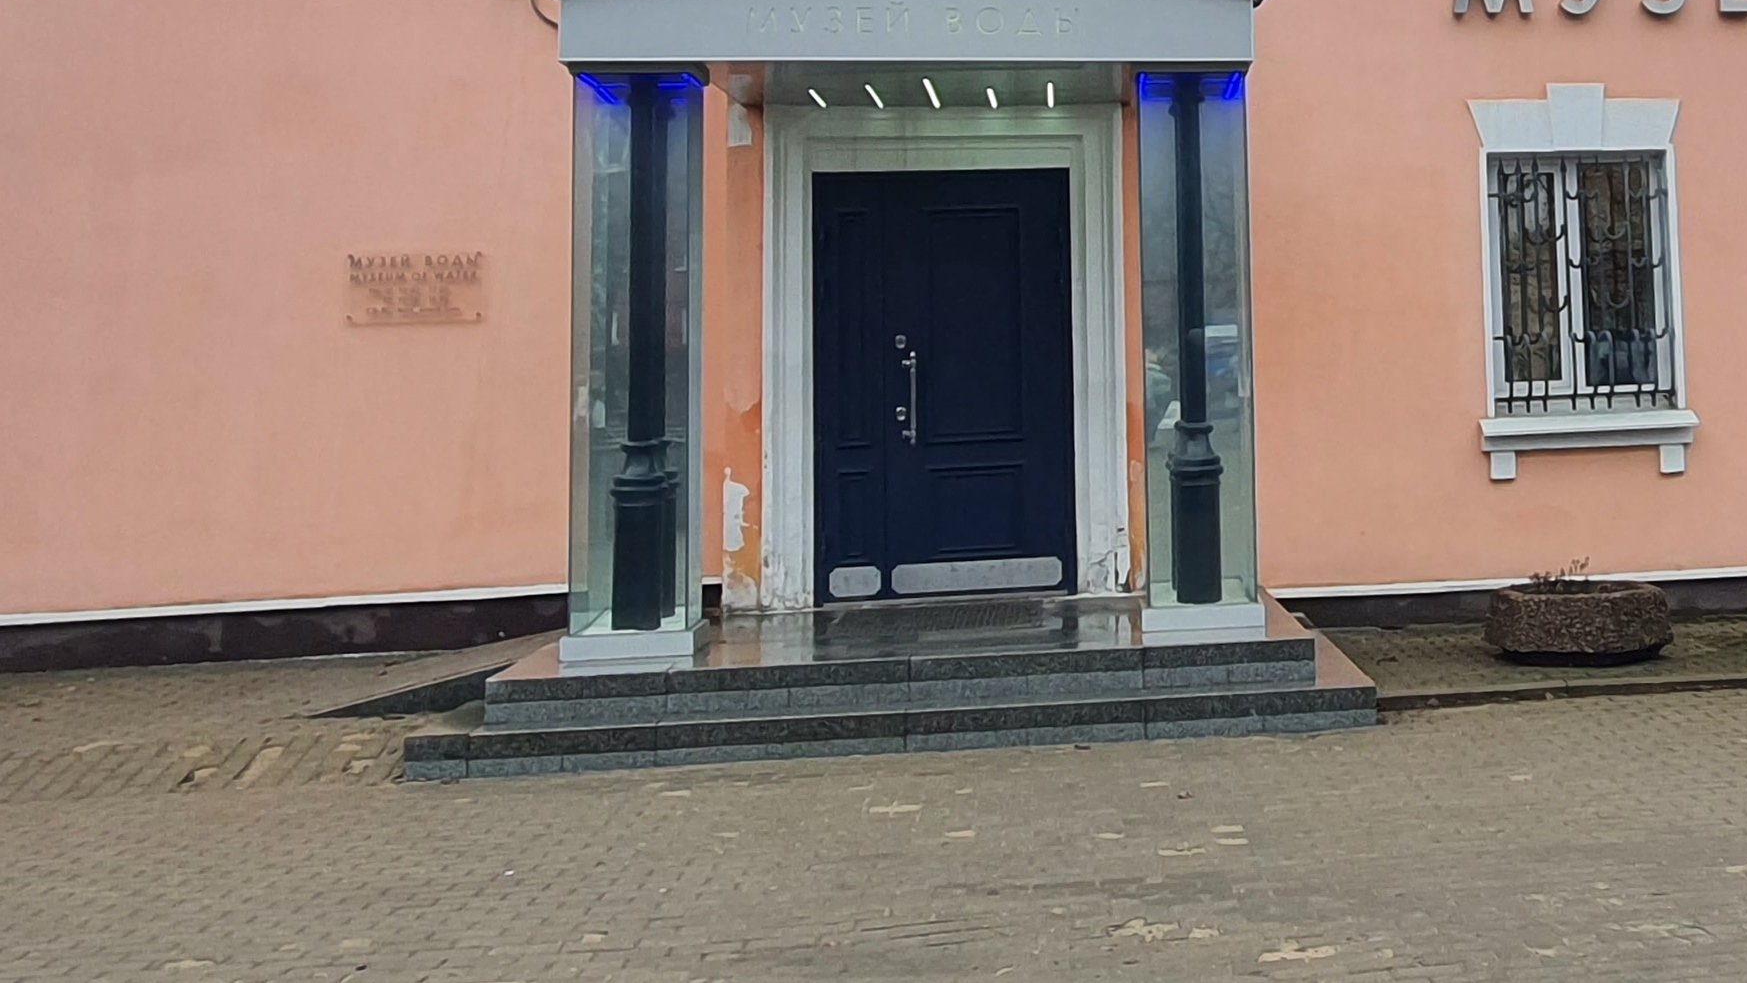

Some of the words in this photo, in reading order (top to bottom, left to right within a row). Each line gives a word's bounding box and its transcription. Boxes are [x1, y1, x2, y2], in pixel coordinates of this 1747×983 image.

[745, 0, 910, 34] МУЗЕЙ
[350, 254, 410, 268] МУЗЕЙ
[412, 271, 427, 281] OF
[434, 270, 477, 282] WATER
